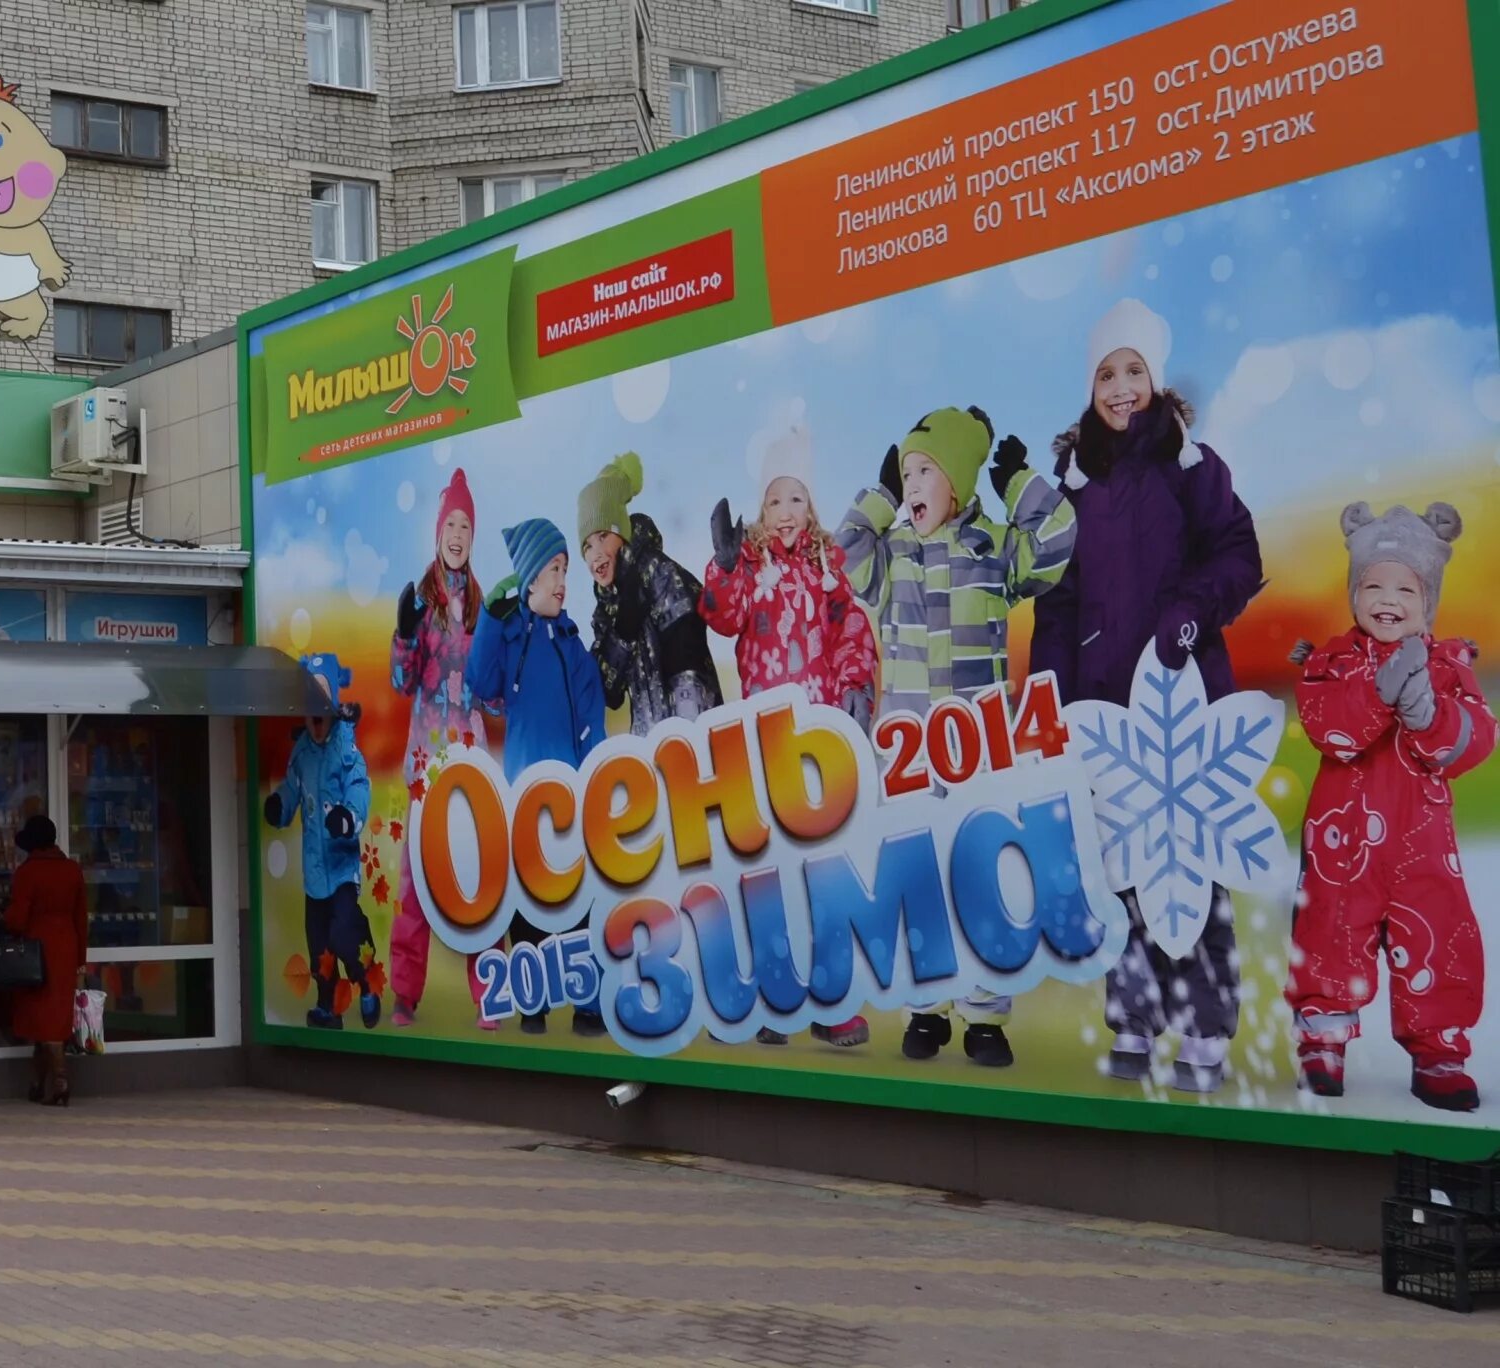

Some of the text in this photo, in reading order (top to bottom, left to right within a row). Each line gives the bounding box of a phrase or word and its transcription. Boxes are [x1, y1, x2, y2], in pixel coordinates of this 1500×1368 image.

[834, 5, 1358, 201] Ленинский проспект 150 ост.Остужева
[835, 43, 1385, 238] Ленинский проспект 117 ост.Димитрова
[837, 111, 1316, 274] Лизюкова 60 ТЦ «Аксиома» 2 этаж
[546, 272, 722, 341] МАГАЗИН-МАЛЫШОК.РФ
[593, 263, 668, 302] Наш сайт
[320, 413, 443, 456] сеть детских магазинов
[97, 619, 175, 640] Игрушки
[419, 678, 1069, 928] Осень 2014
[477, 932, 598, 1020] 2015
